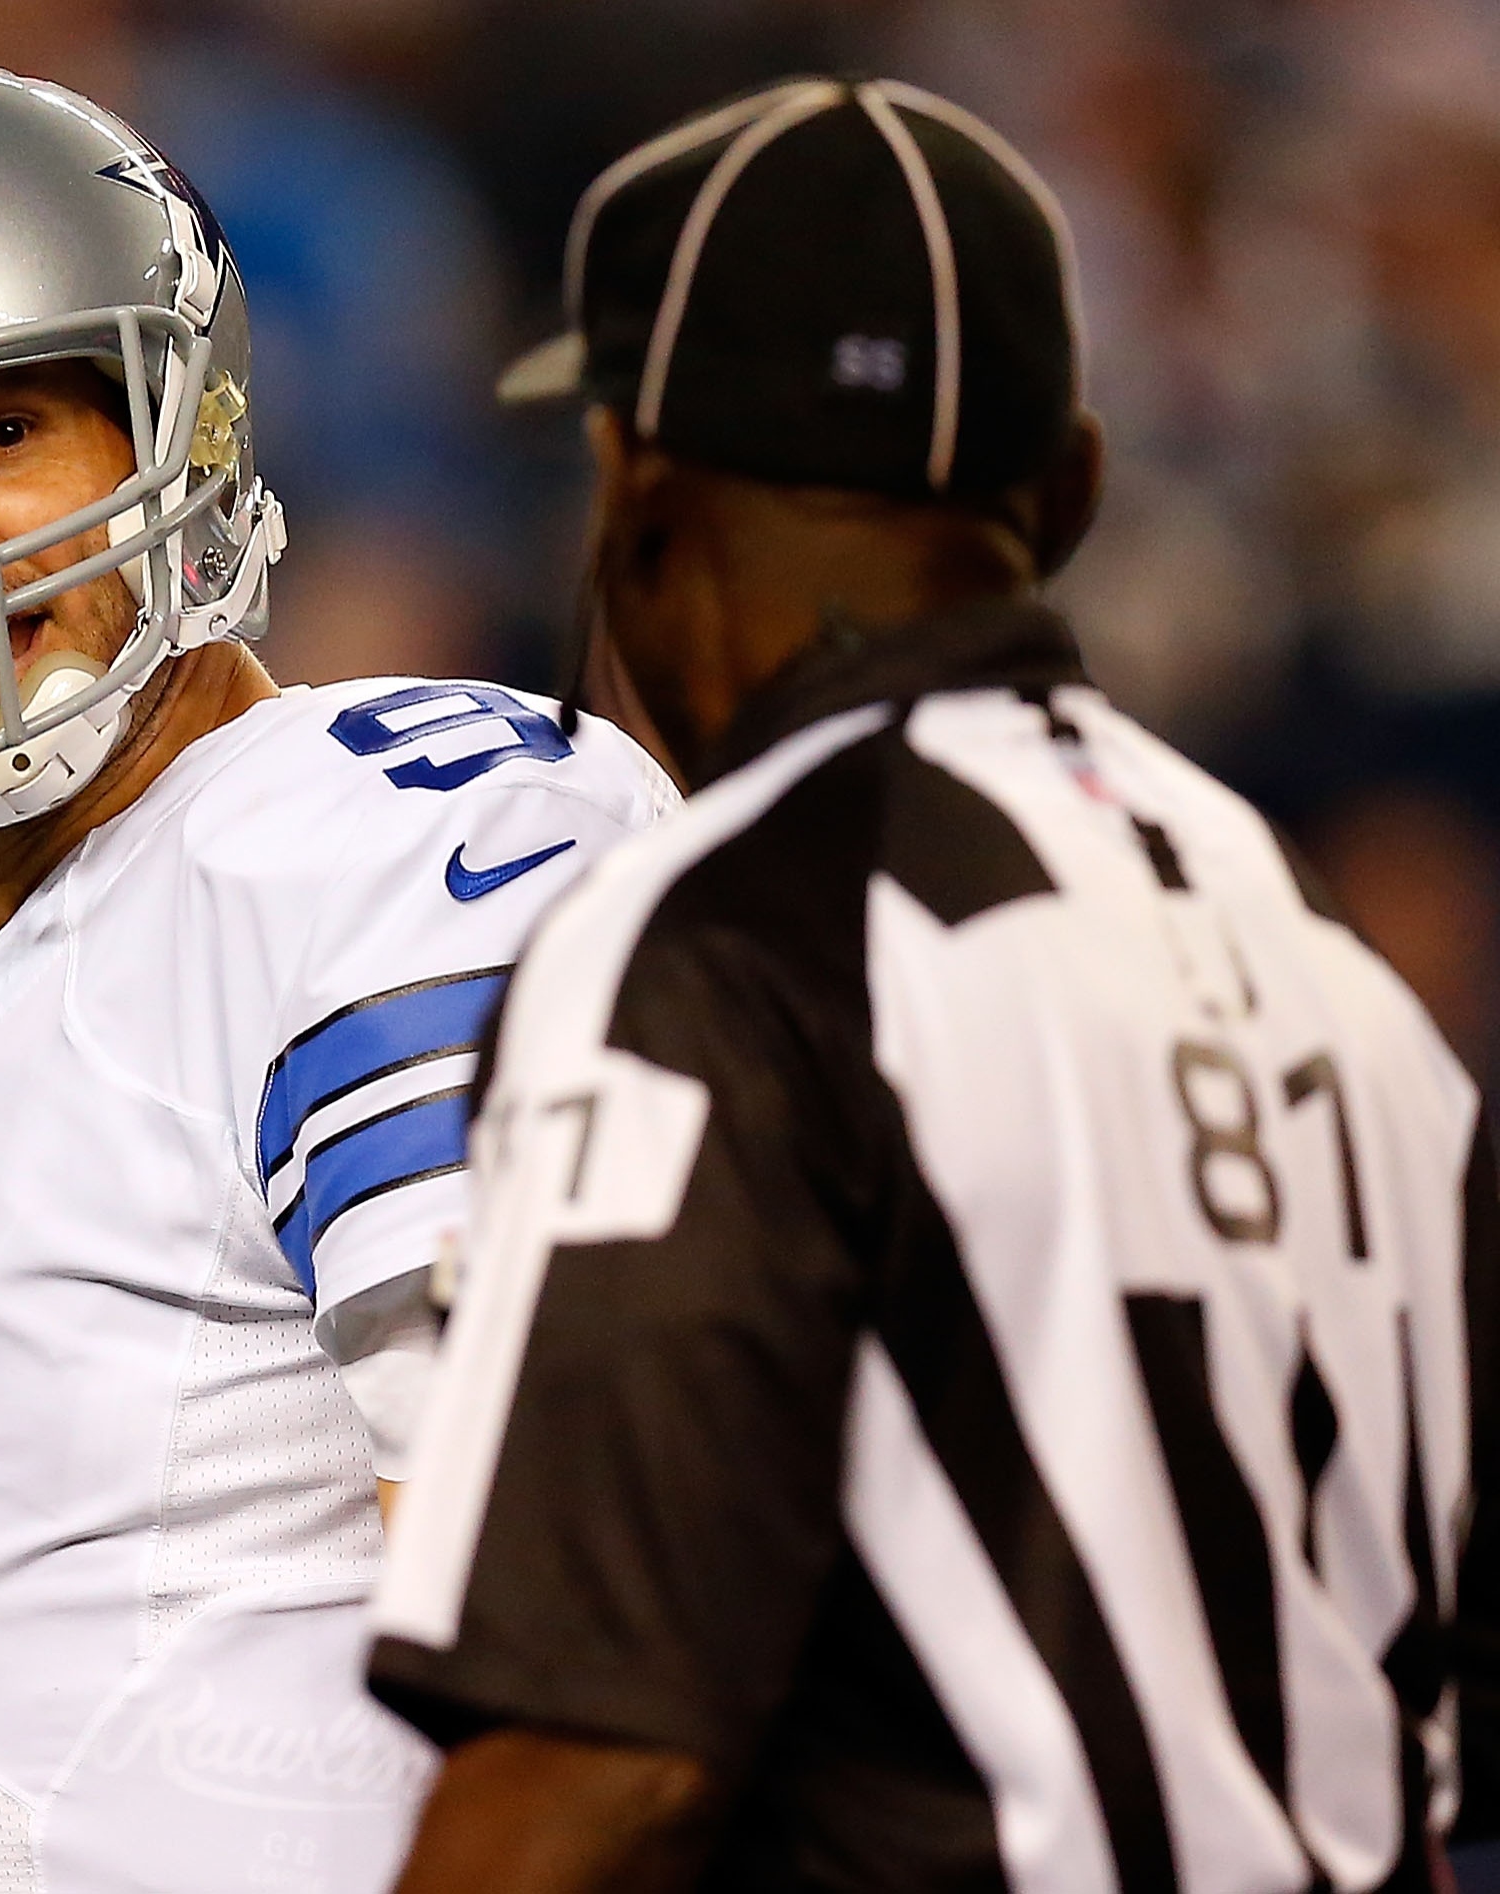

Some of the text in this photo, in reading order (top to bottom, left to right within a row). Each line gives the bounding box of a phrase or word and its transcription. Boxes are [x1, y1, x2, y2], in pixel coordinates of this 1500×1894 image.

[326, 684, 576, 792] 9
[1173, 1038, 1370, 1261] 81
[94, 1674, 425, 1810] Rawlin
